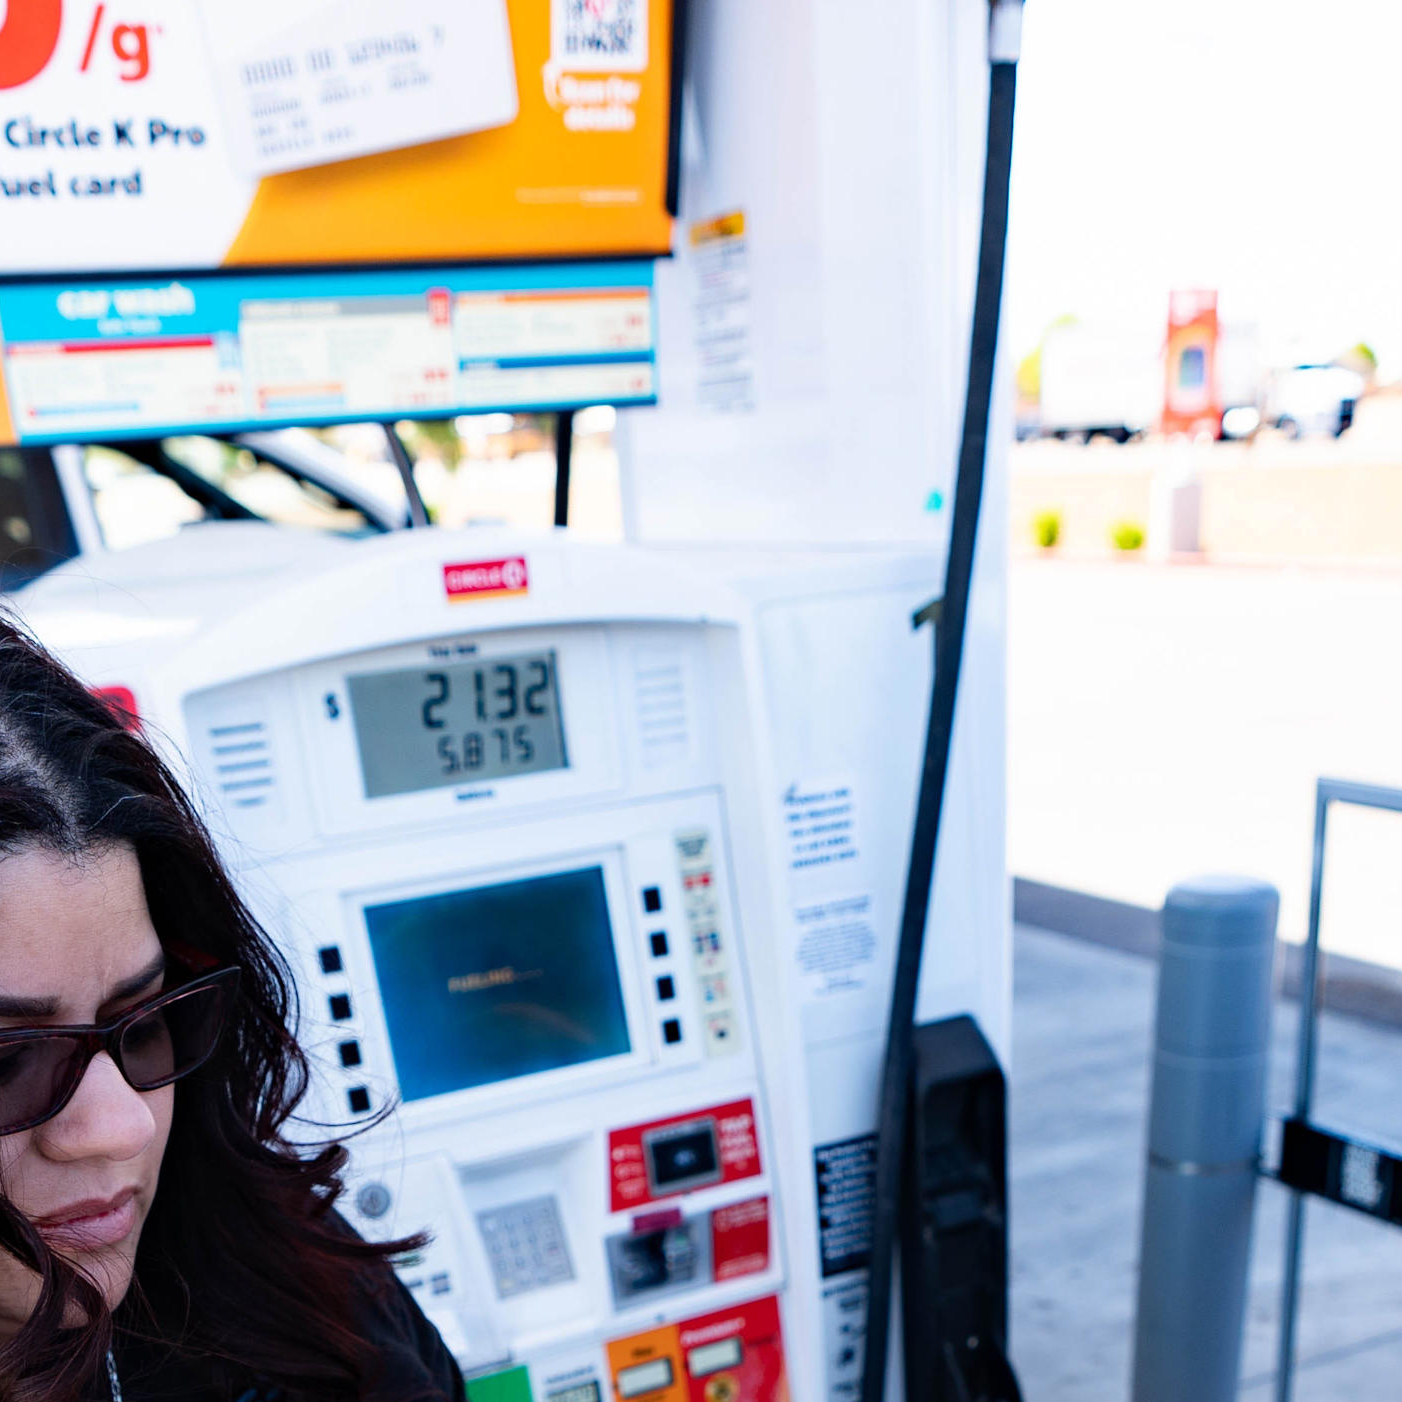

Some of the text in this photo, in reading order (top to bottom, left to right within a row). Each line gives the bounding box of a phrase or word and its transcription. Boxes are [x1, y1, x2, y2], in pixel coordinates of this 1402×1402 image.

[3, 116, 101, 148] Circle
[113, 118, 136, 147] K
[147, 118, 206, 147] Pro
[69, 168, 144, 197] card
